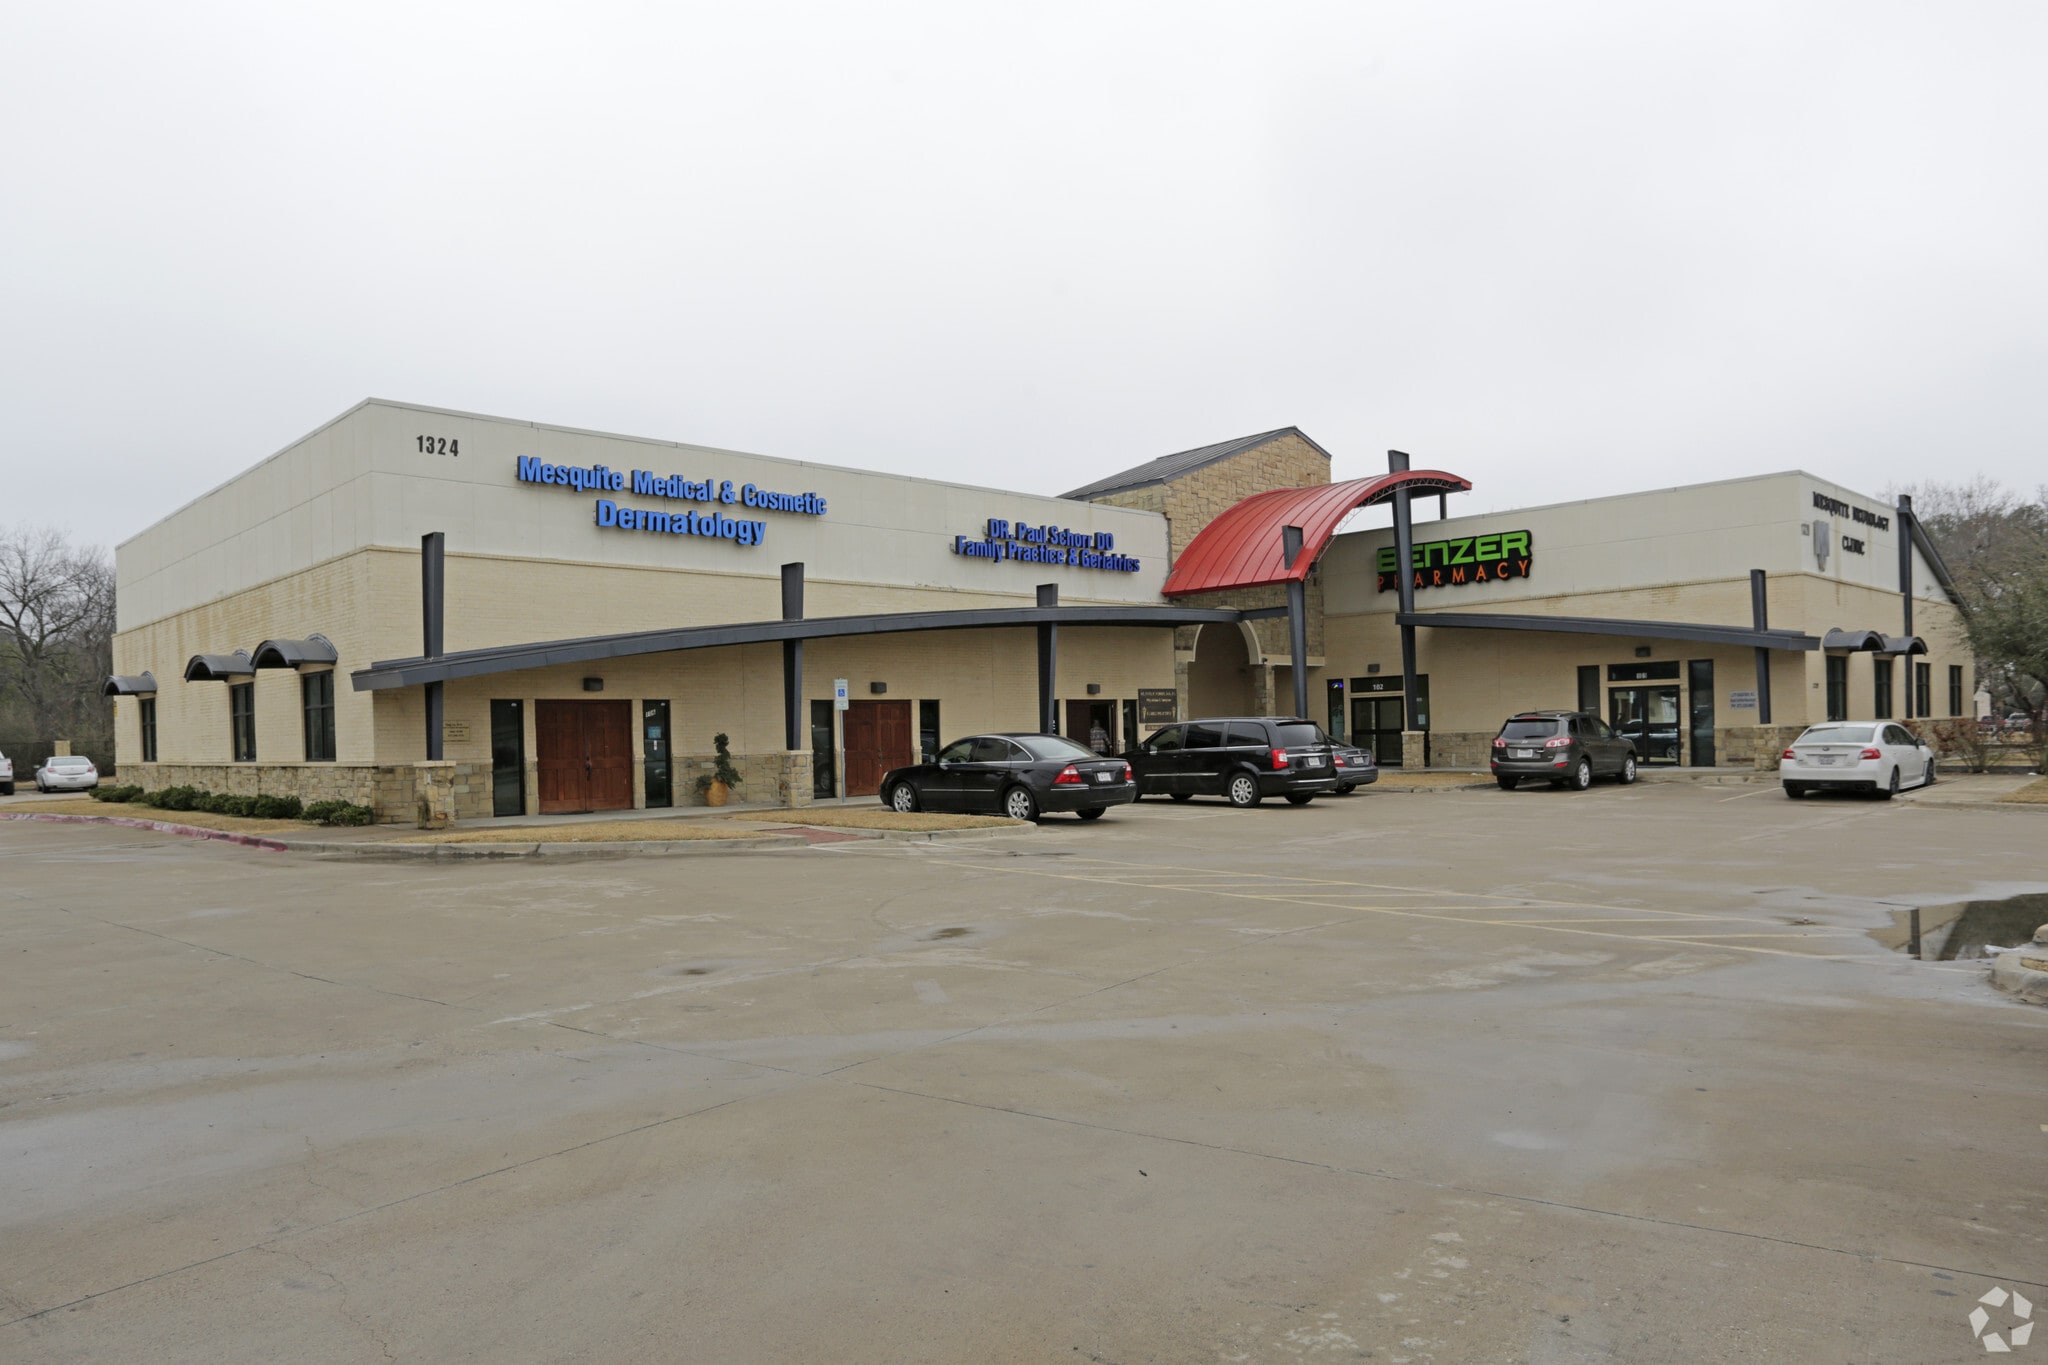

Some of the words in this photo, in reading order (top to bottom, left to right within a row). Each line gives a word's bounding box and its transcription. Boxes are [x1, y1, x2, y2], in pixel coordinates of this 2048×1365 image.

[416, 435, 460, 457] 1324
[516, 456, 625, 492] Mesquite
[630, 469, 714, 502] Medical
[719, 480, 736, 505] &
[742, 483, 828, 515] Cosmetic
[595, 499, 767, 546] Dermatology
[987, 518, 1015, 539] DR.
[1015, 522, 1047, 543] Paul
[1048, 525, 1093, 549] Schorr
[954, 535, 1004, 563] Family
[1005, 541, 1066, 565] Practice
[1066, 548, 1079, 567] &
[1079, 548, 1141, 573] Geriatrics
